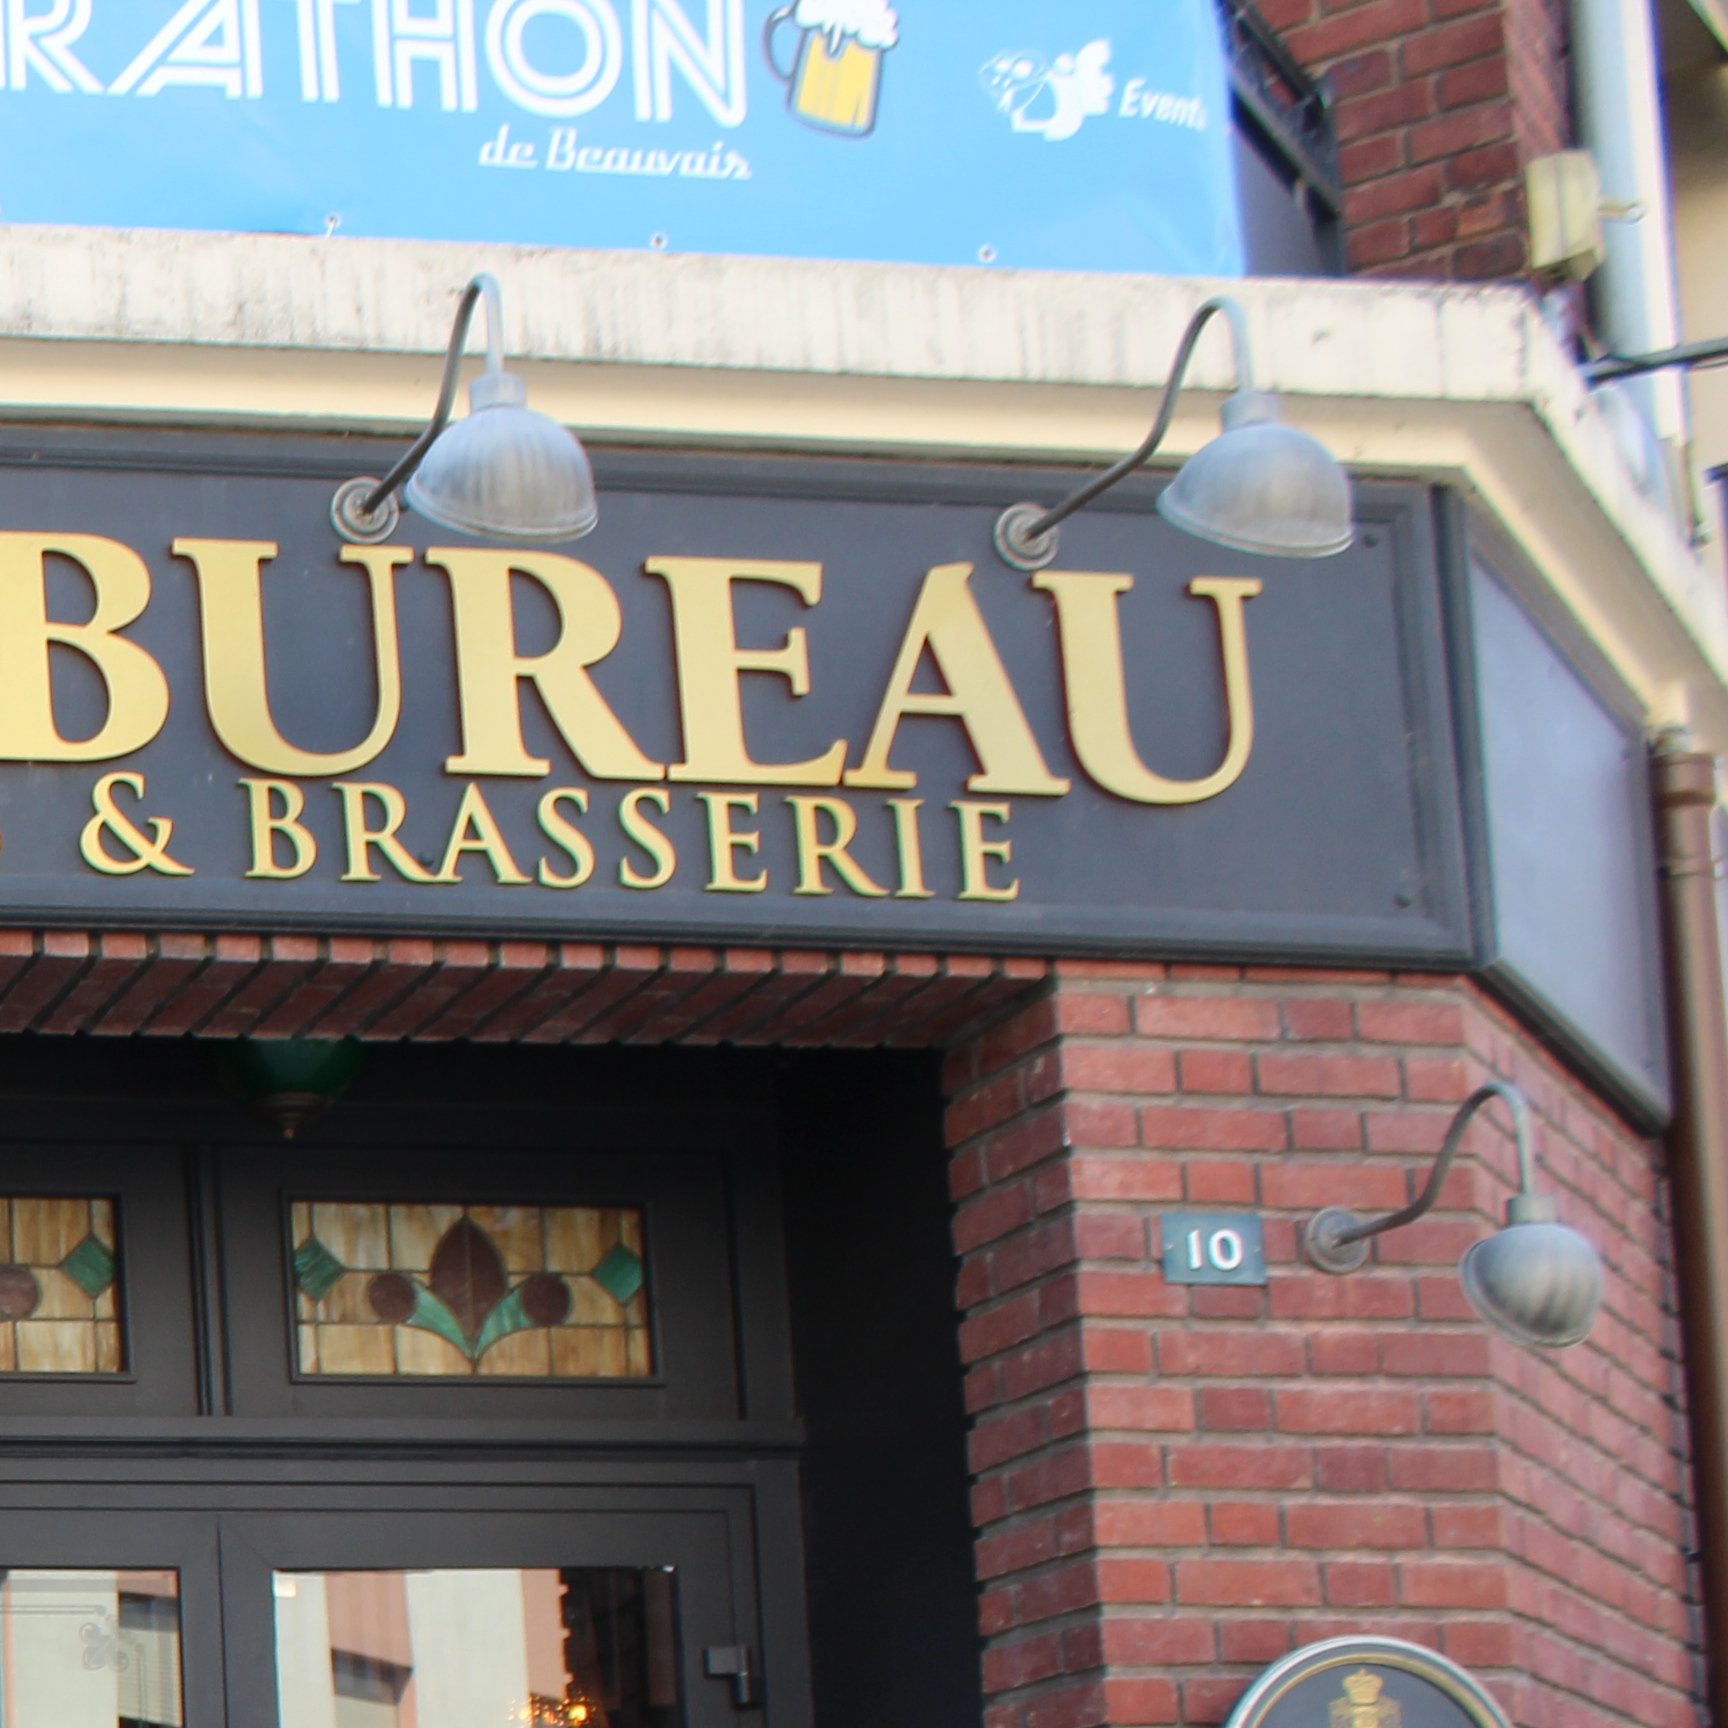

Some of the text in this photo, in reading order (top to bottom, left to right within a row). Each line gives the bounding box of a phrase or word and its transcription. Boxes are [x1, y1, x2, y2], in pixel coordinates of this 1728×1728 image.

[478, 123, 753, 180] de Beauvais
[79, 771, 195, 877] &
[236, 776, 1021, 903] BRASSERIE
[1187, 1228, 1244, 1272] 10
